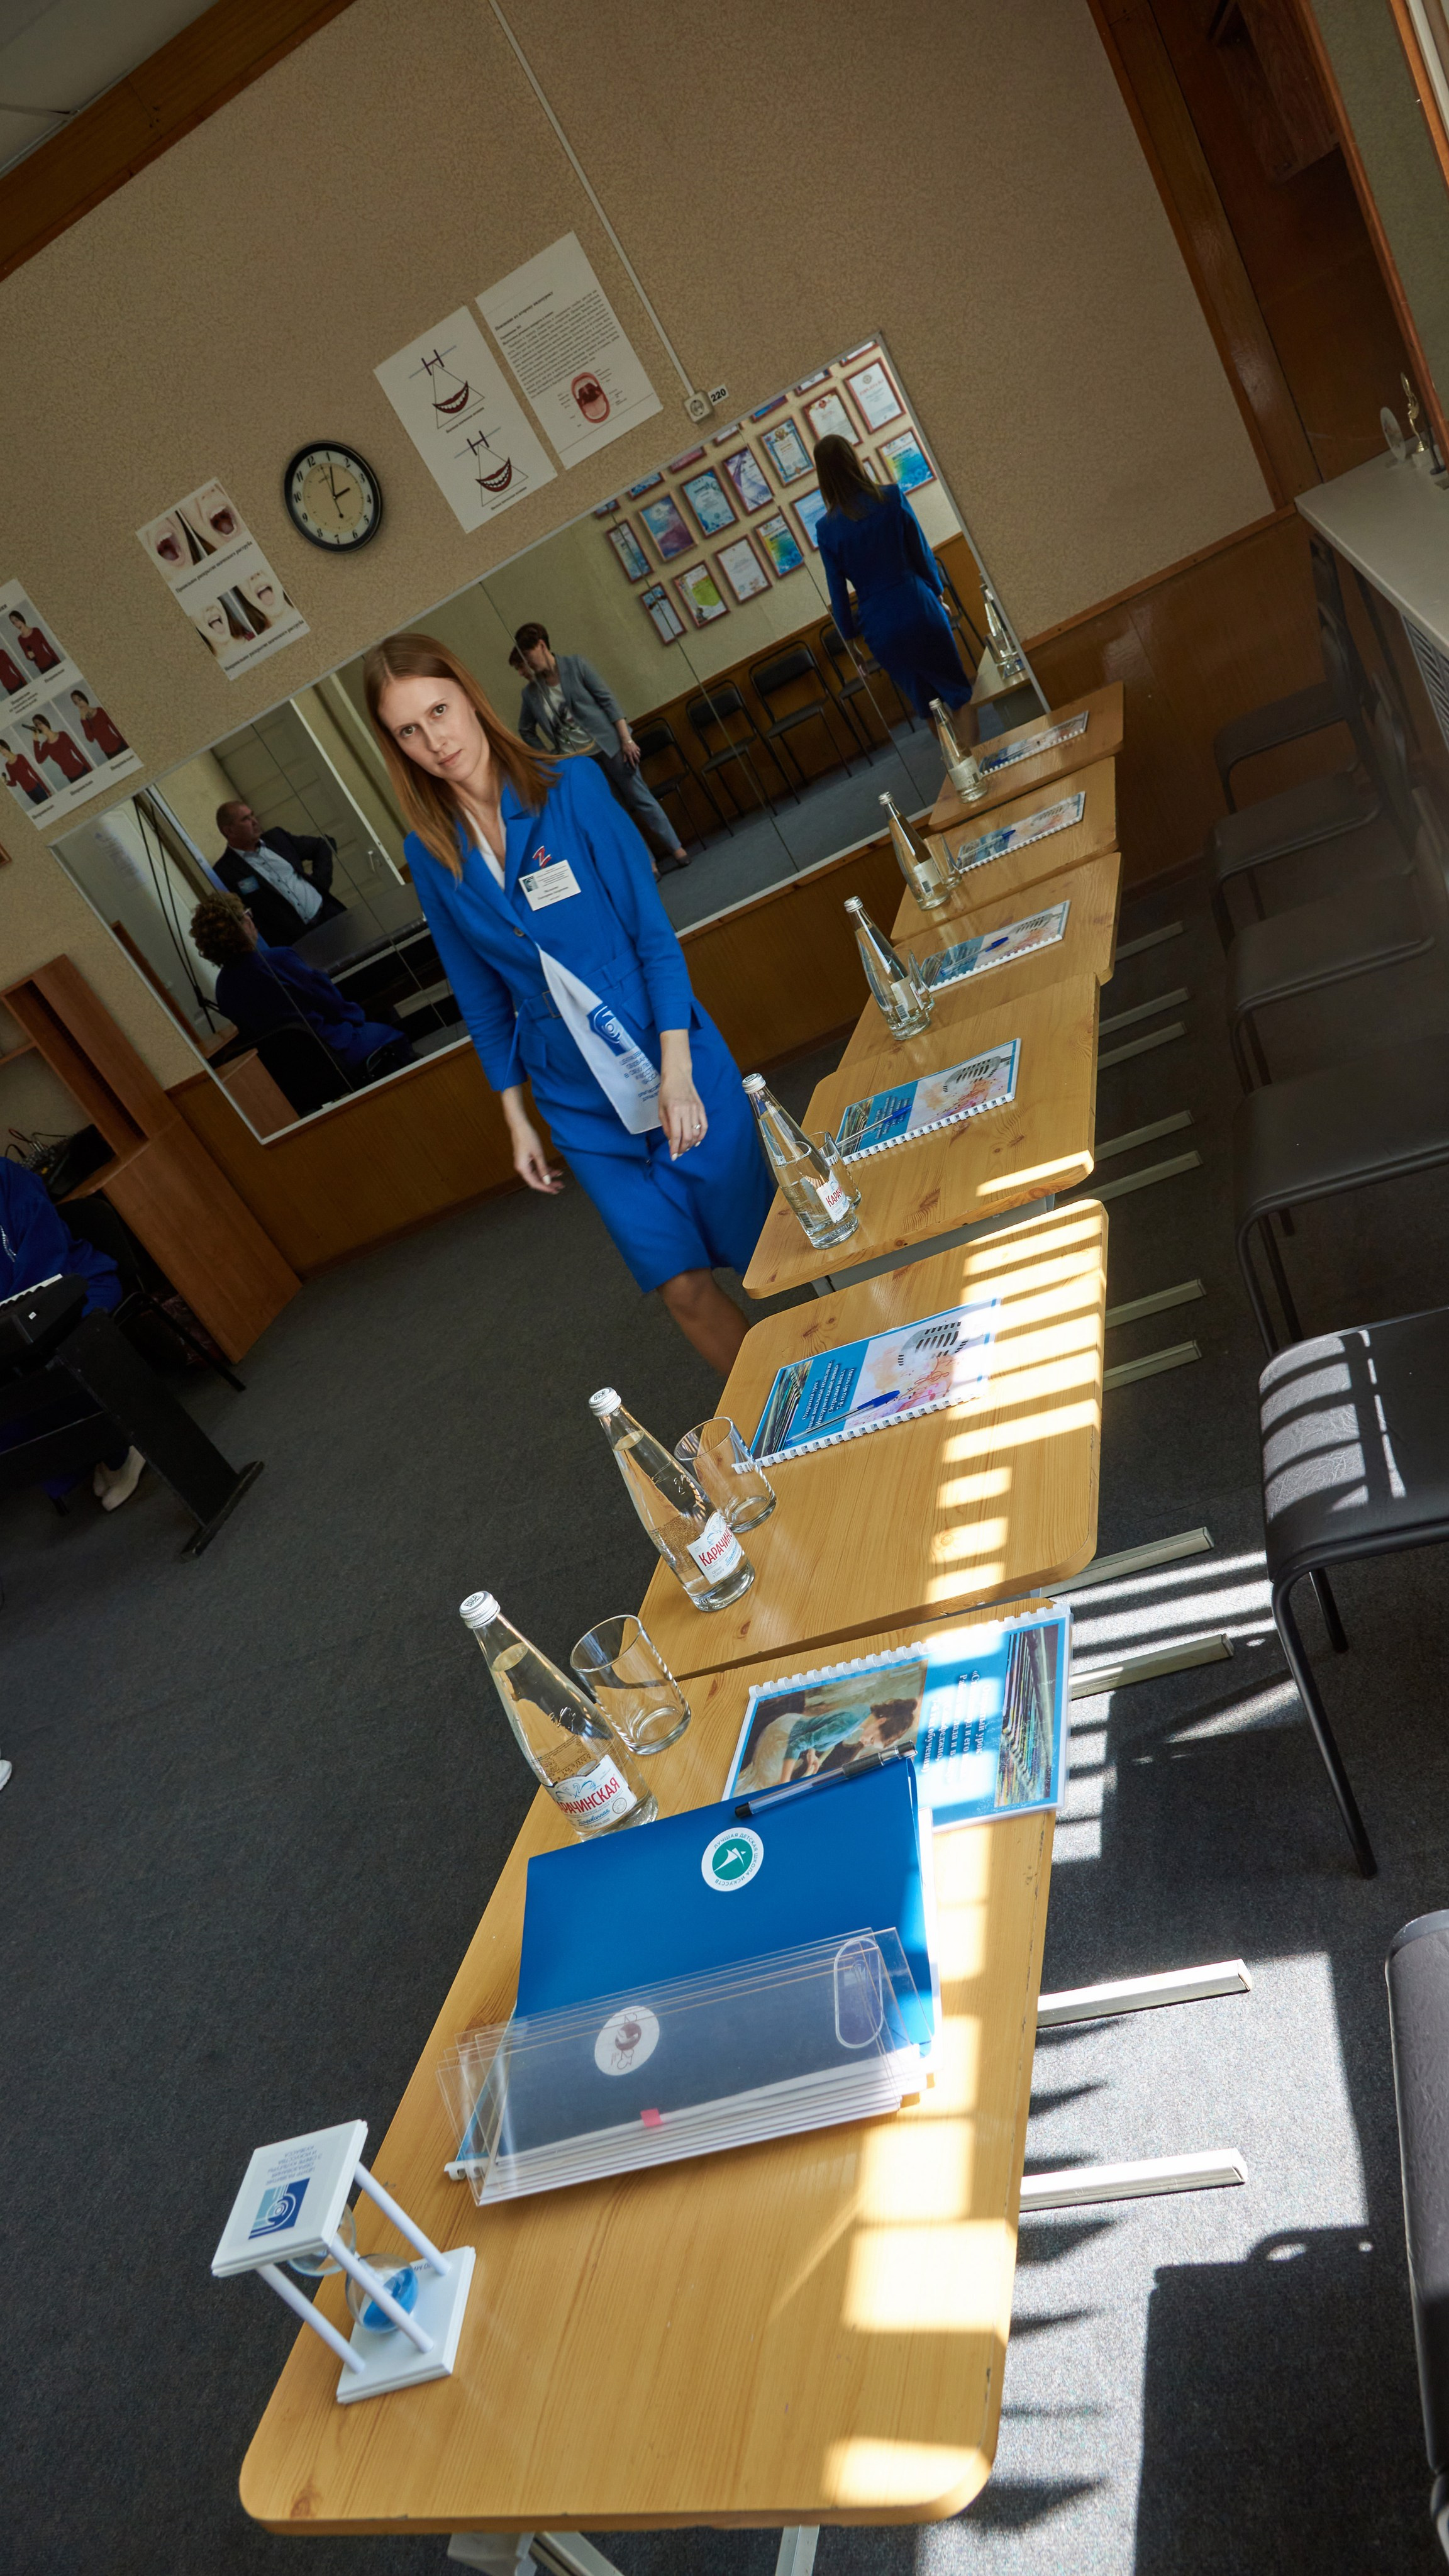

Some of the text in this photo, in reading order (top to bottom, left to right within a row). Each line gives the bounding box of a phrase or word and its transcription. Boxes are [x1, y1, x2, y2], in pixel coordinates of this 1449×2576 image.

[711, 388, 726, 402] 220
[307, 455, 316, 468] 12
[326, 452, 331, 462] 1
[344, 458, 350, 468] 2
[296, 470, 304, 482] 11
[358, 473, 365, 484] 3
[294, 491, 302, 503] 10
[367, 494, 372, 504] 4
[302, 513, 308, 523] 9
[364, 515, 370, 525] 5
[317, 528, 323, 538] 8
[334, 534, 340, 544] 7
[352, 529, 358, 538] 6
[843, 1368, 855, 1394] обучения)
[802, 1392, 815, 1420] Открытый
[813, 1389, 824, 1415] вокальные
[828, 1385, 841, 1414] (Эстрадный
[952, 1720, 961, 1740] лада
[963, 1738, 971, 1752] его
[975, 1731, 985, 1755] урок
[921, 1729, 936, 1774] обучения)
[557, 1777, 621, 1814] АРАЧИНСКАЯ
[714, 1833, 758, 1886] ЛУЧШАЯ ДЕТСКАЯ ШКОЛА ИСКУССТВ
